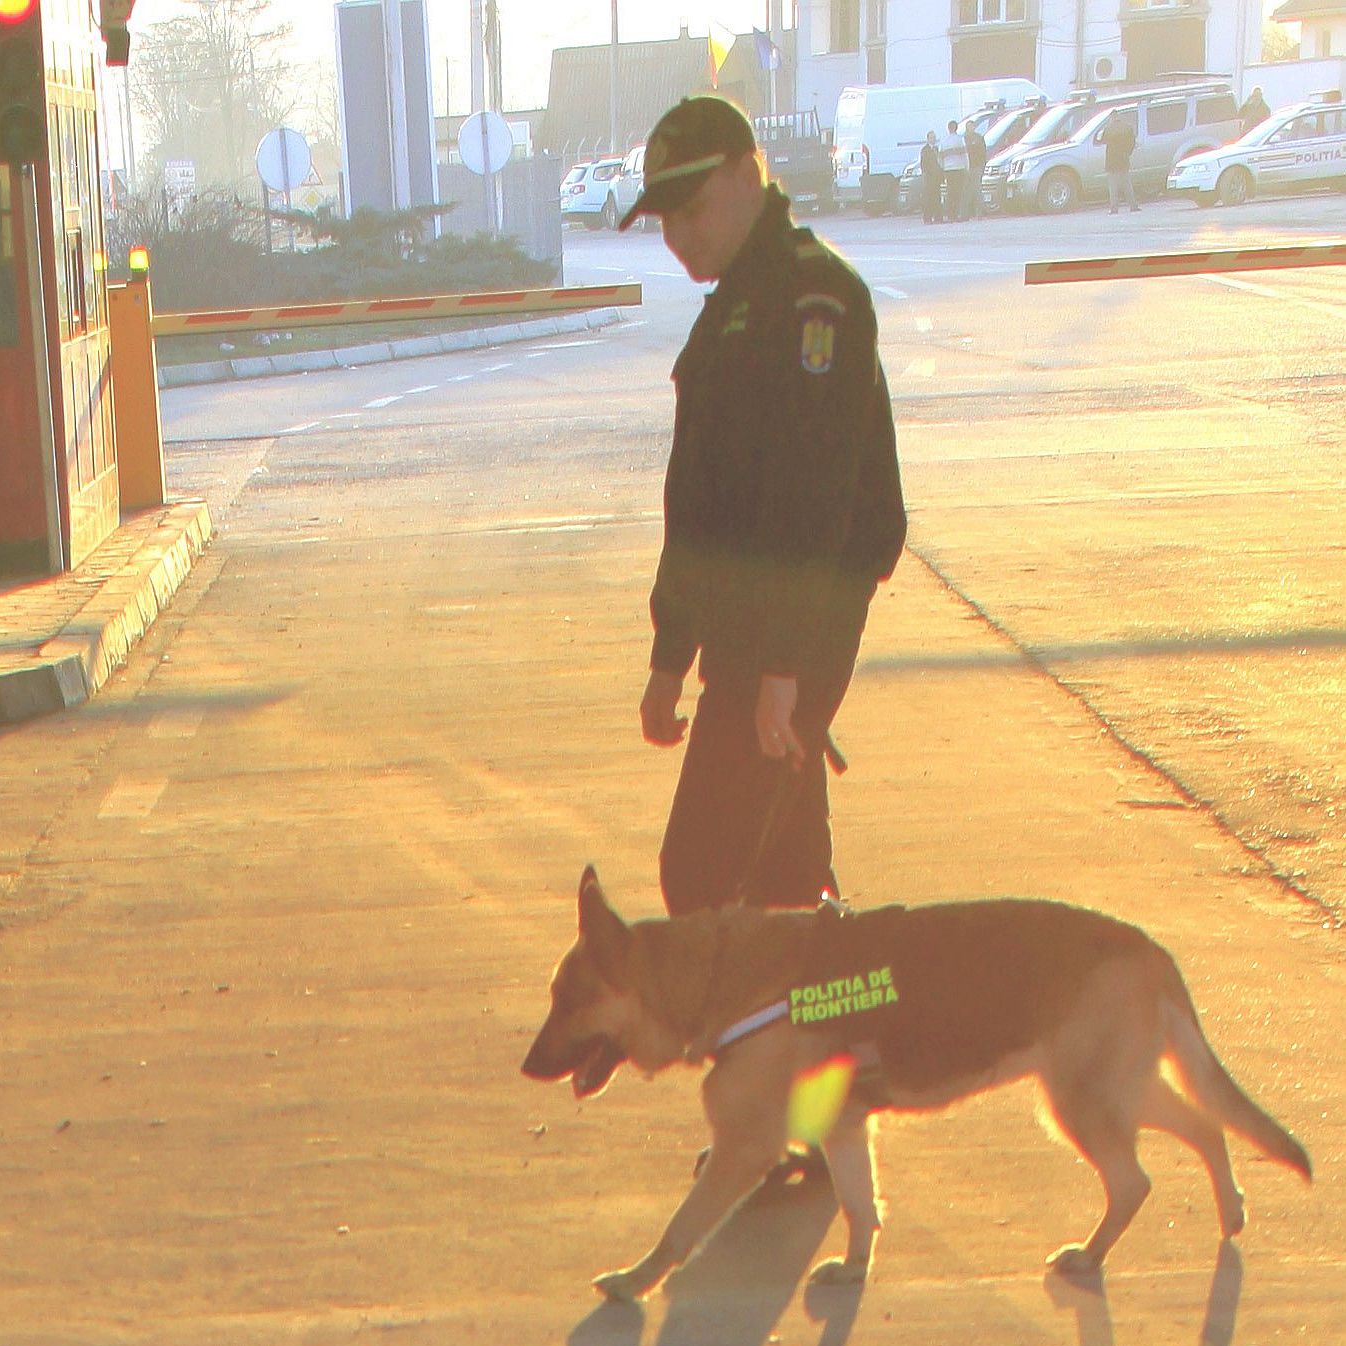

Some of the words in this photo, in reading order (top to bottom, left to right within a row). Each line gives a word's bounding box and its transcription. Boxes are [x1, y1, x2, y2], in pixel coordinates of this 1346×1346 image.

[790, 976, 864, 1006] POLITIA
[868, 967, 892, 986] DE
[790, 987, 899, 1025] FRONTIERA
